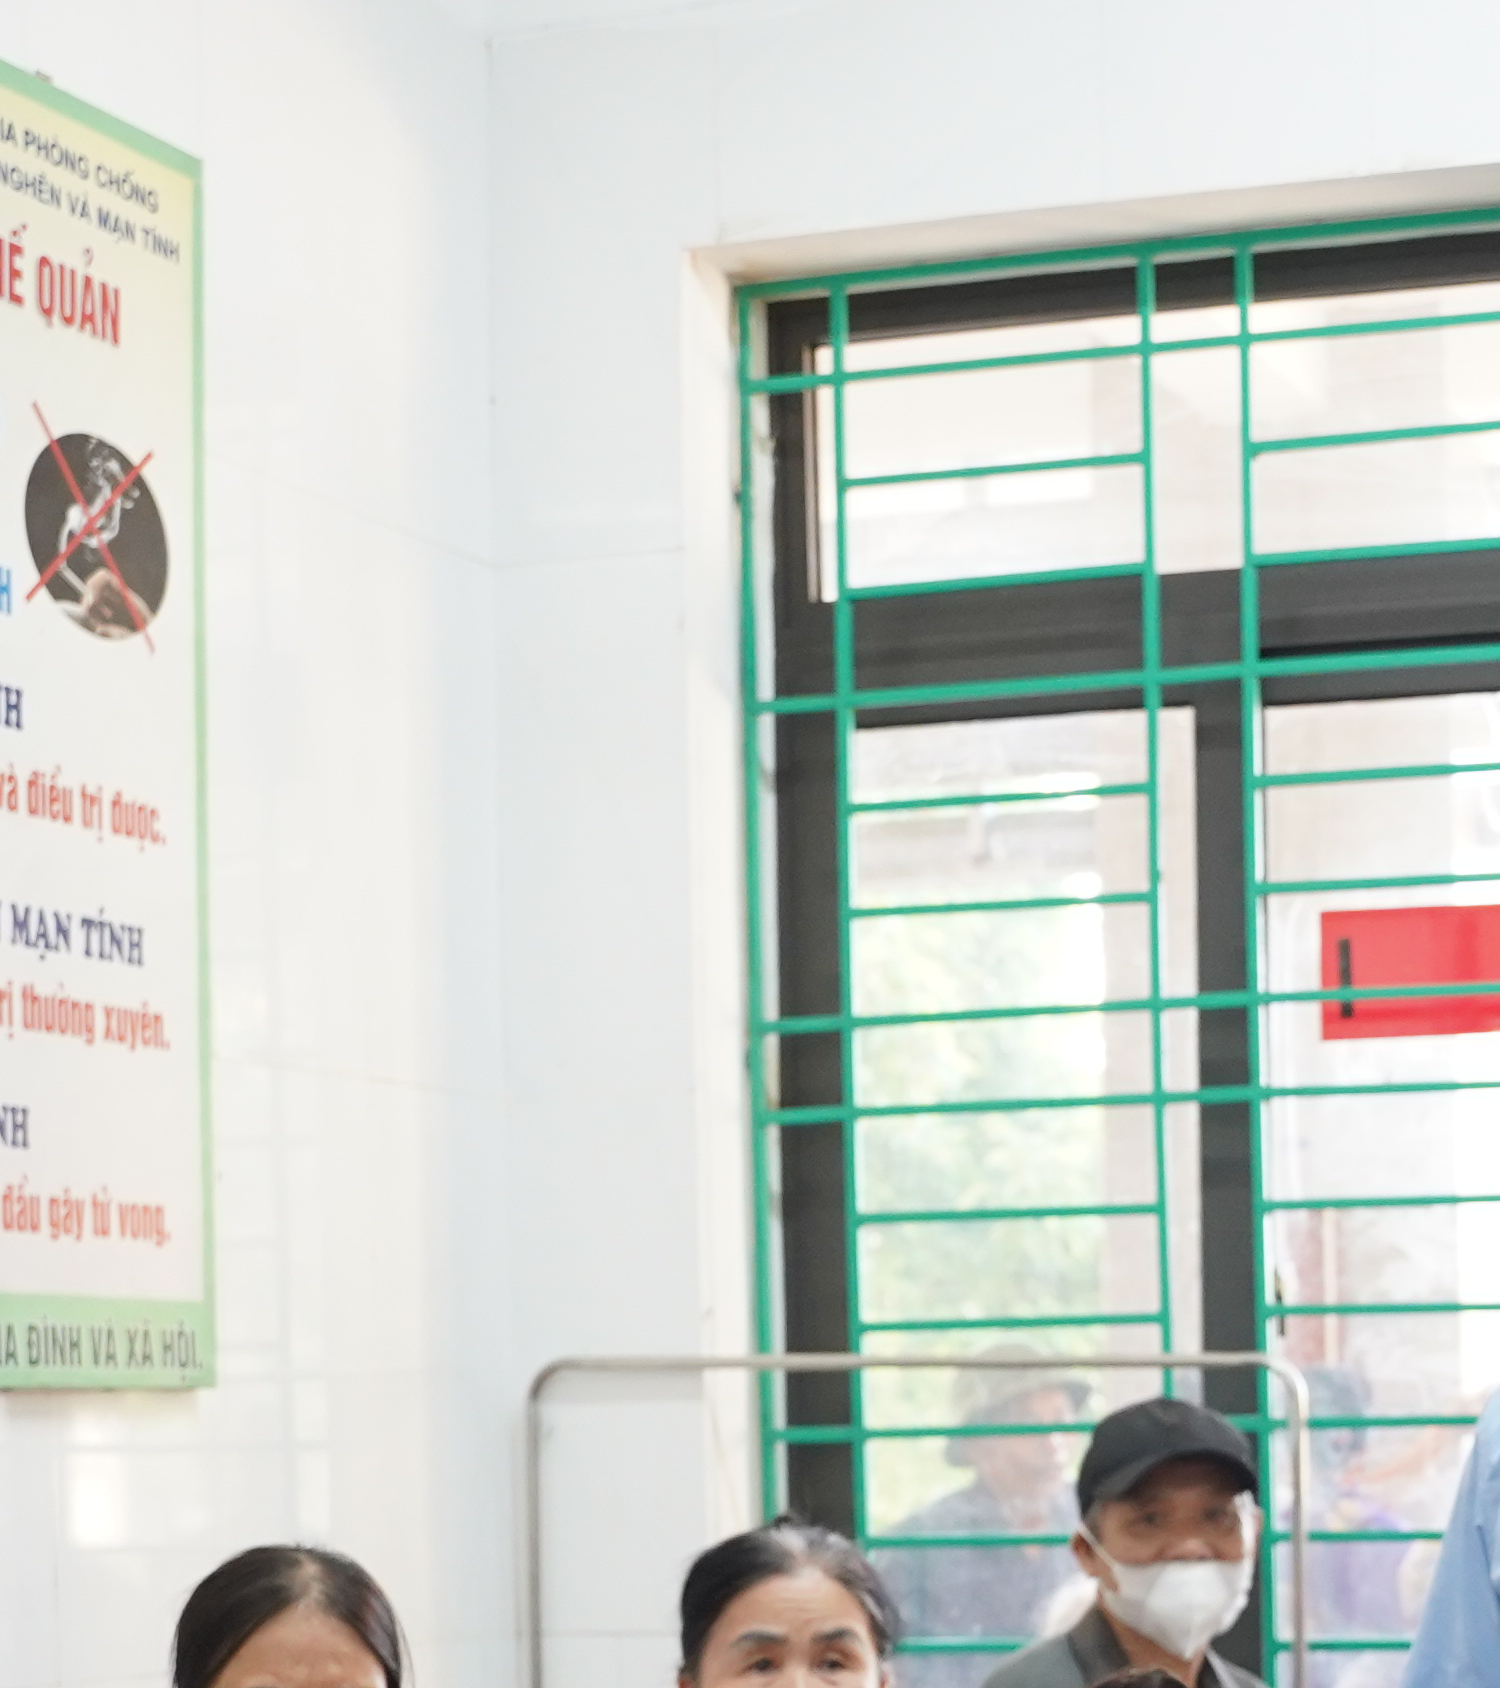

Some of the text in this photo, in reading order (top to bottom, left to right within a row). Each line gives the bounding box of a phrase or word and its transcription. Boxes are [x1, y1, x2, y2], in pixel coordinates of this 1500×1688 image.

[23, 128, 90, 181] PHÒNG
[94, 163, 161, 215] CHỐNG
[66, 187, 93, 221] VÀ
[96, 205, 137, 245] MẠN
[140, 225, 182, 265] TÍNH
[37, 246, 121, 347] QUẢN
[27, 764, 75, 825] điều
[80, 783, 104, 843] trị
[111, 789, 167, 852] được.
[10, 901, 73, 962] MẠN
[81, 905, 145, 968] TÍNH
[21, 980, 96, 1047] thường
[103, 1001, 171, 1053] xuyên.
[2, 1173, 42, 1233] đầu
[48, 1185, 86, 1242] gây
[118, 1201, 172, 1248] vong.
[28, 1314, 82, 1368] ĐÌNH
[89, 1317, 119, 1368] VÀ
[125, 1318, 156, 1368] XÃ
